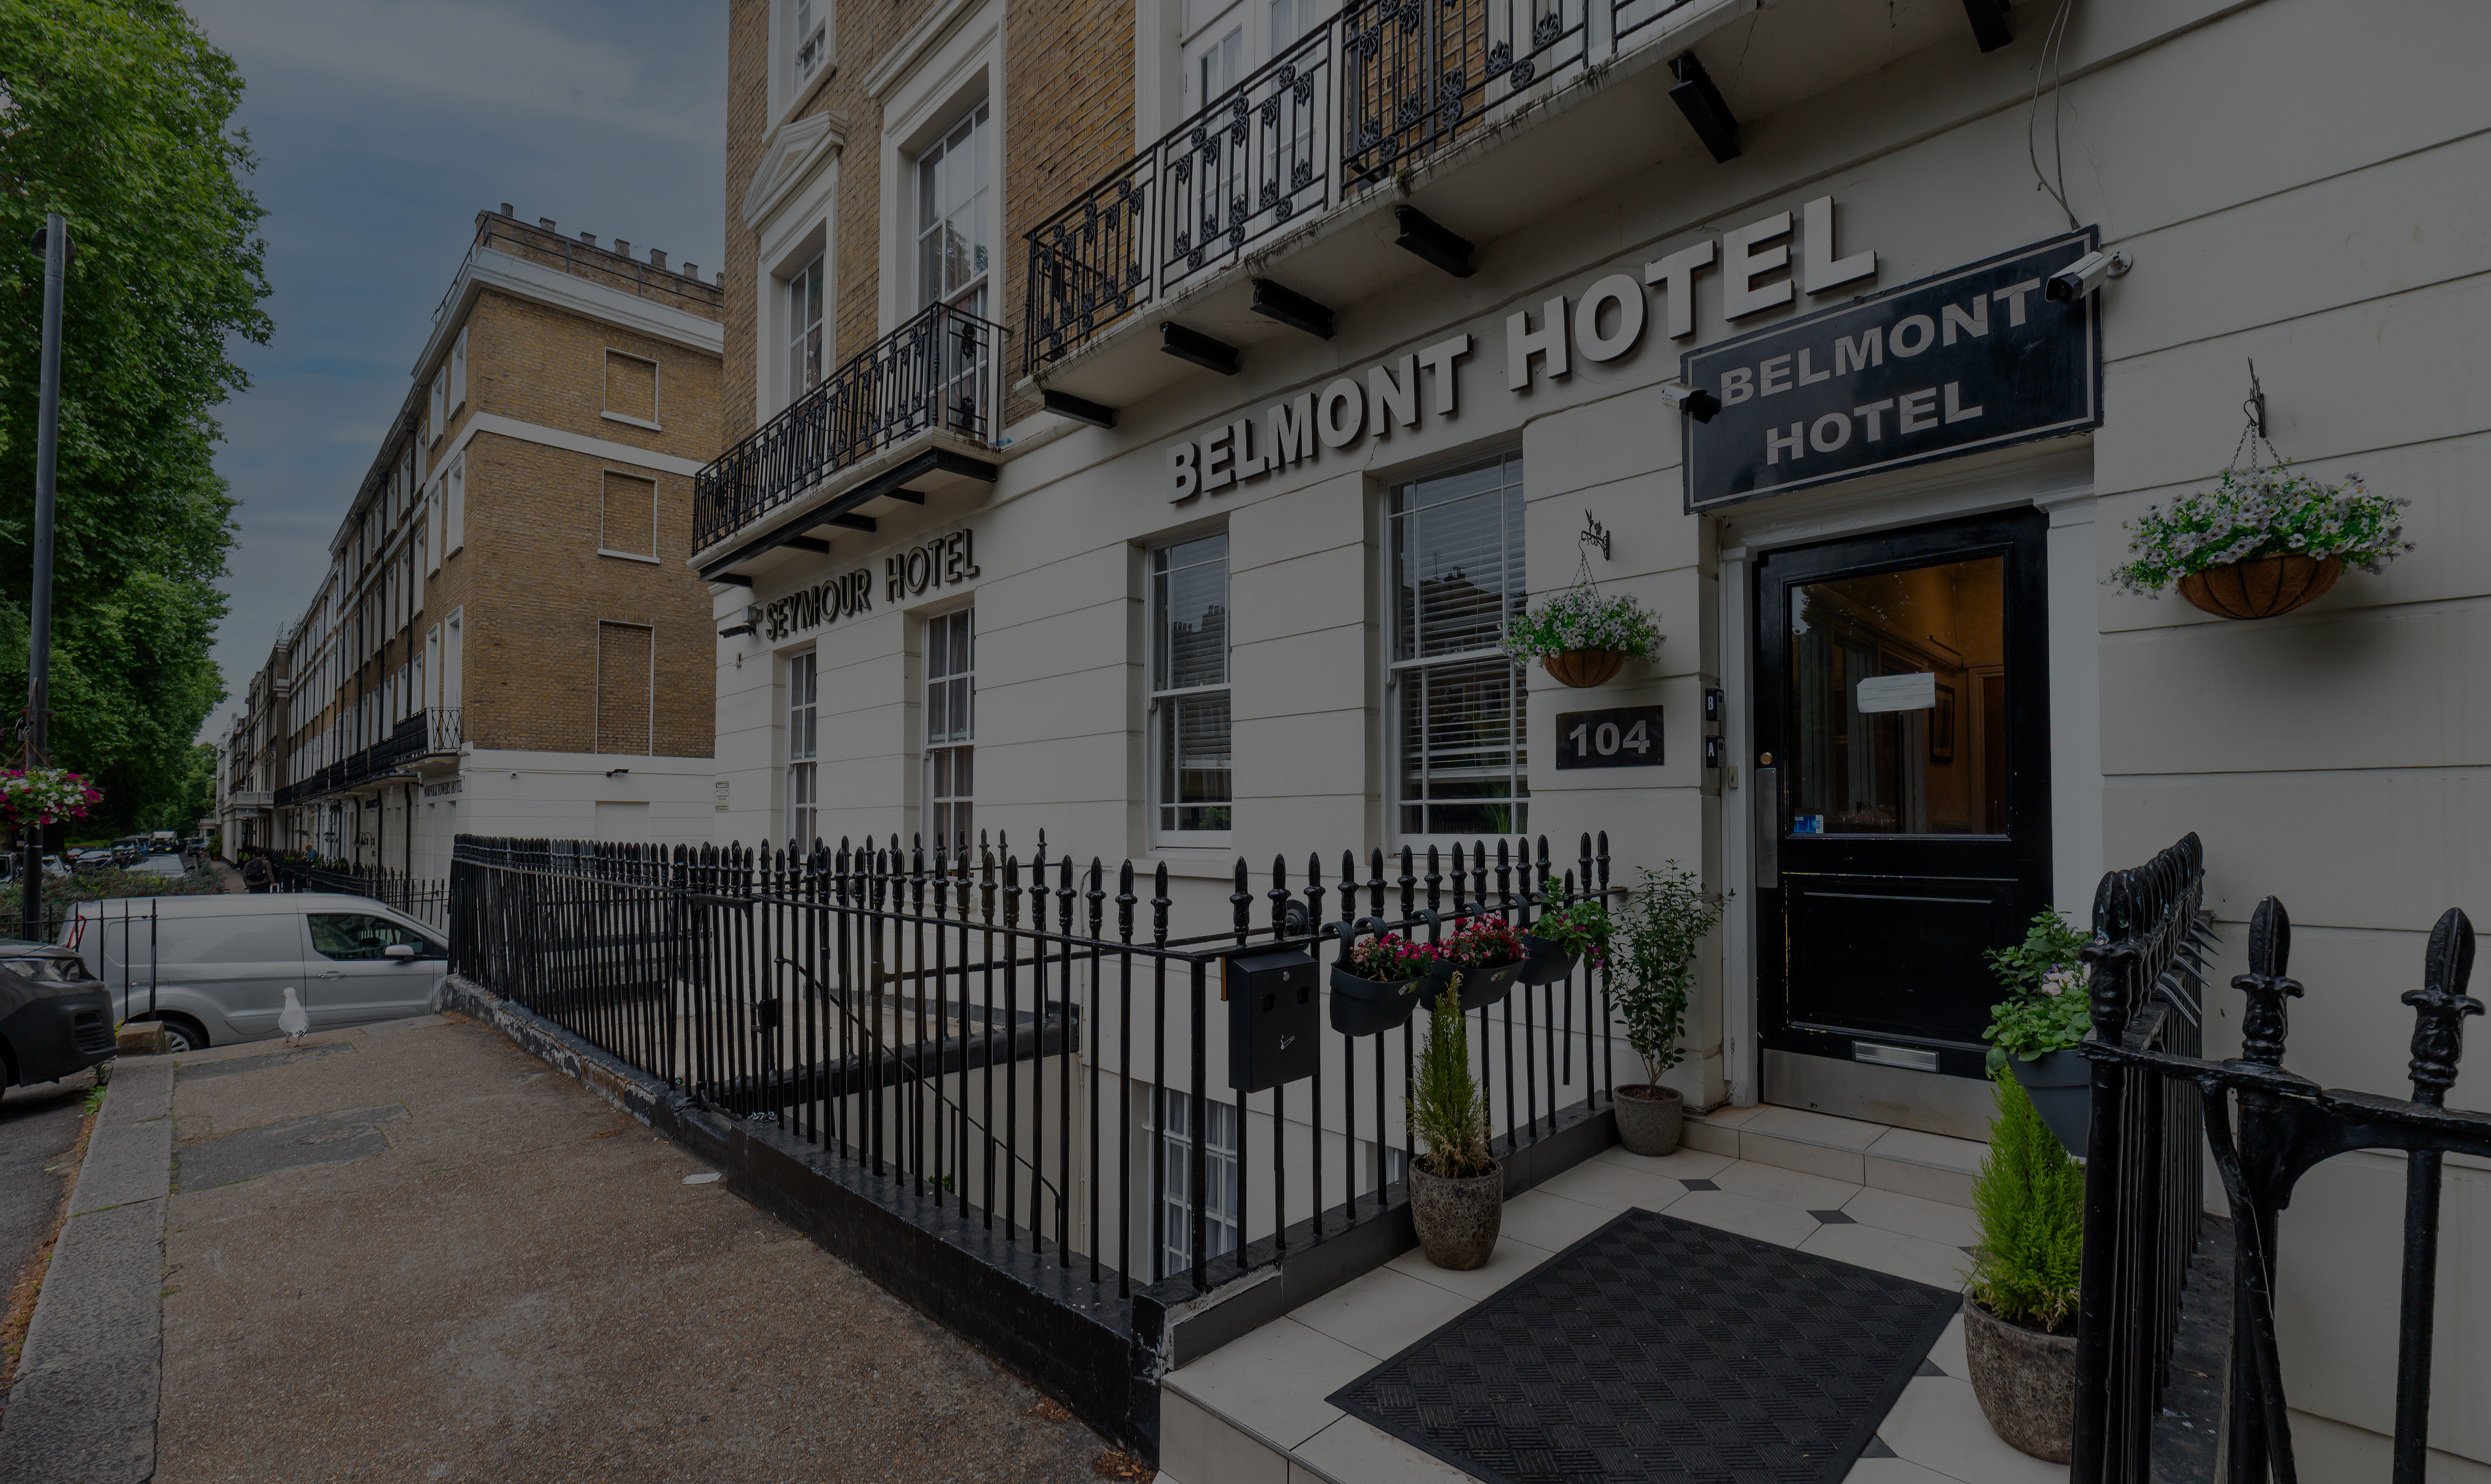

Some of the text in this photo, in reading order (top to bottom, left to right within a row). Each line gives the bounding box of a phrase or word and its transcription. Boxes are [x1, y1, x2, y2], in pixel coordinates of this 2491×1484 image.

[1166, 194, 1877, 504] BELMONT HOTEL
[1720, 277, 2040, 408] BELMONT
[1767, 381, 1983, 465] HOTEL
[766, 529, 980, 641] SEYMOUR HOTEL
[1707, 696, 1714, 711] B
[1570, 720, 1651, 756] 104
[1708, 742, 1715, 756] A
[424, 779, 463, 798] NORFOLK TOWERS HOTEL
